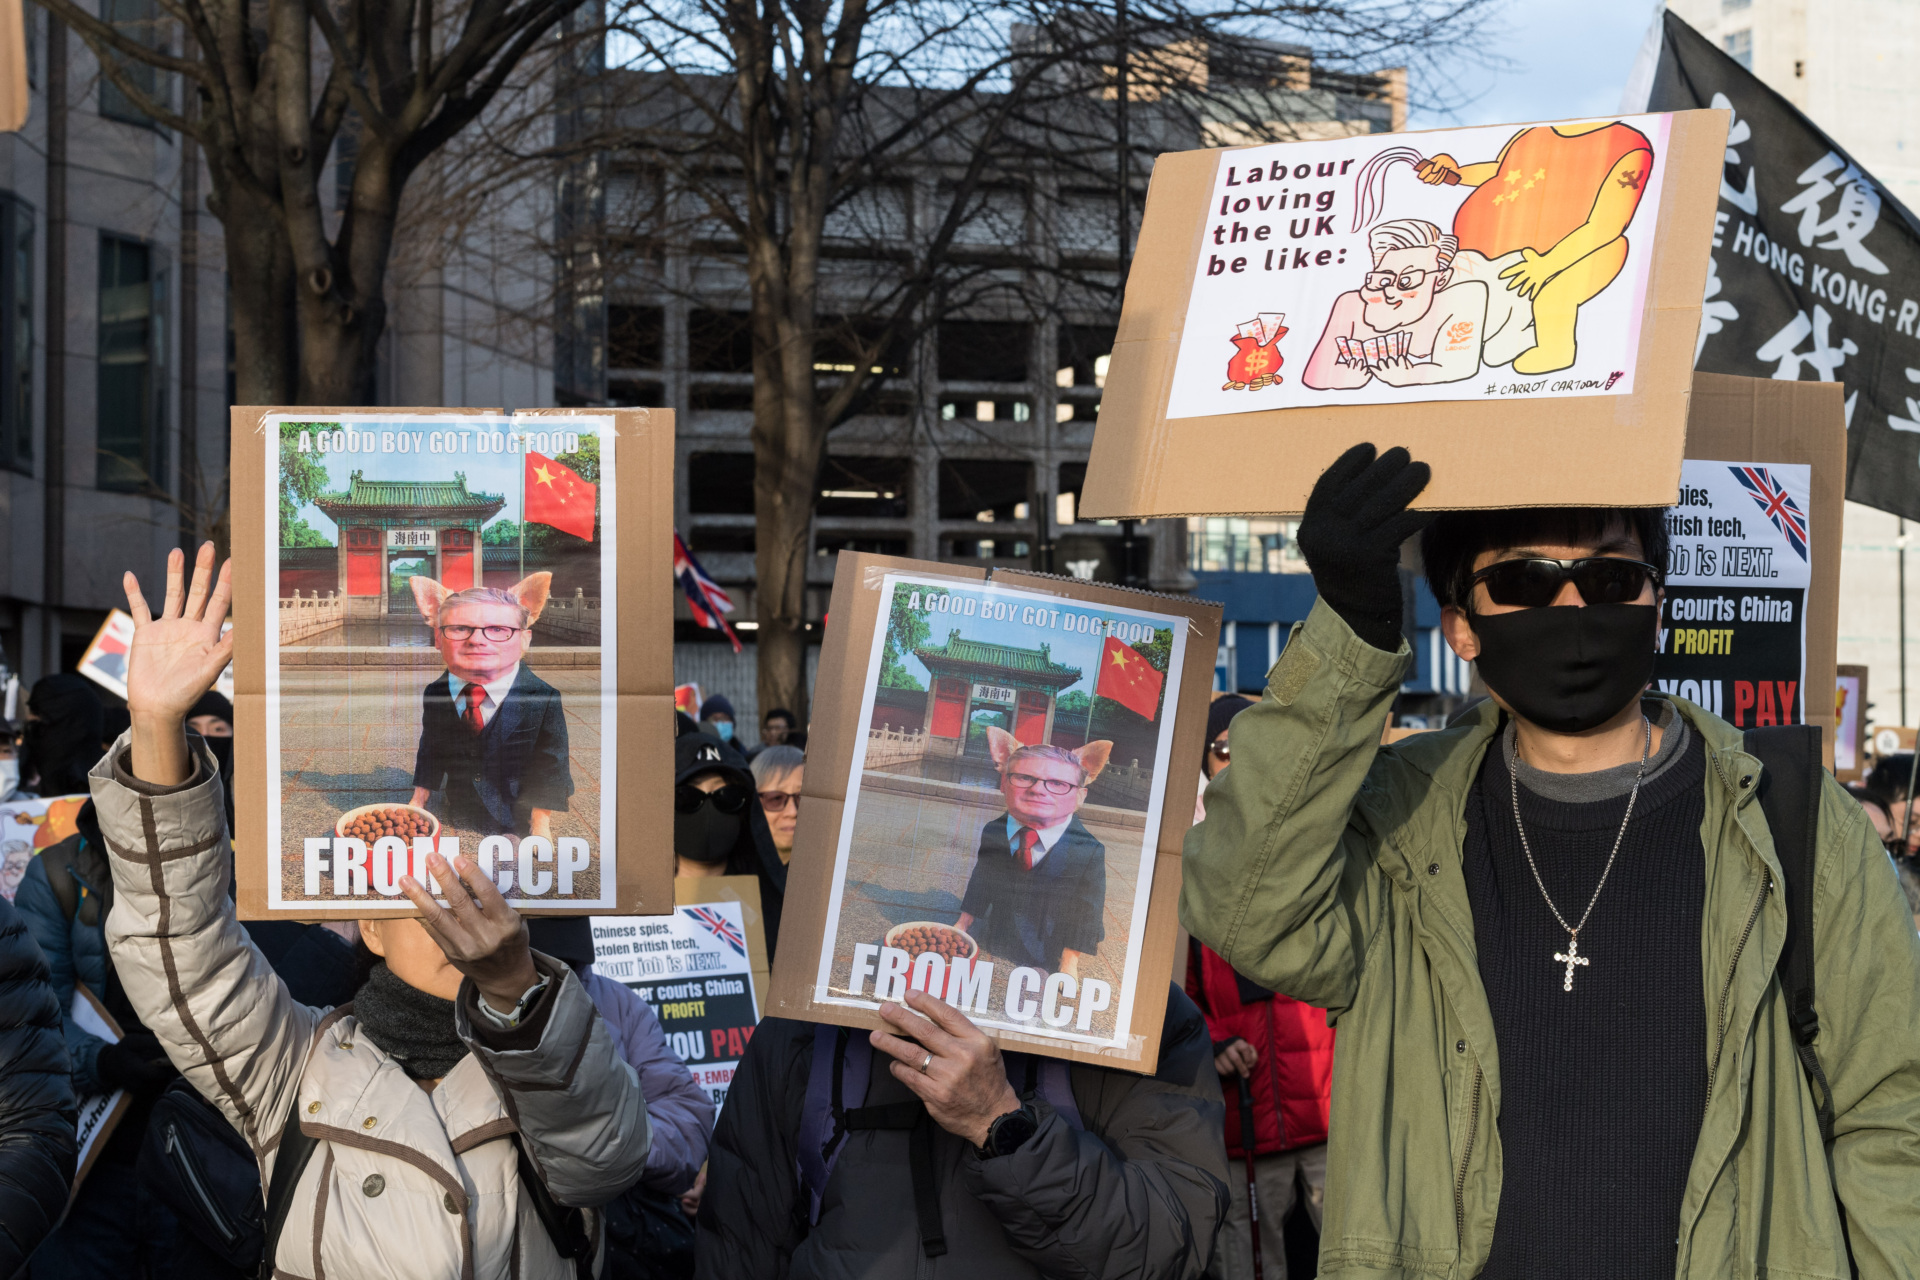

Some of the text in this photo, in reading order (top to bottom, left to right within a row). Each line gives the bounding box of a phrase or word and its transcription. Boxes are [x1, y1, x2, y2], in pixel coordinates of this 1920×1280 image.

[1226, 159, 1355, 186] Labour
[1220, 188, 1335, 216] loving
[1213, 215, 1336, 245] the UK
[1207, 248, 1347, 276] be like:
[1732, 221, 1805, 287] HONG
[298, 430, 579, 454] A GOOD BOY GOT DOG FOOD
[1675, 484, 1713, 509] pies,
[1668, 515, 1746, 540] itish tech,
[1667, 544, 1778, 578] ob is NEXT.
[907, 591, 1155, 644] A GOOD BOY GOT DOG FOOD
[1671, 596, 1735, 622] courts
[1740, 595, 1793, 623] China
[1673, 628, 1734, 655] PROFIT
[1734, 680, 1797, 727] PAY
[304, 835, 590, 896] FROM CCP
[593, 923, 673, 939] Chinese spies,
[596, 937, 700, 957] stolen British tech,
[597, 952, 727, 978] Your job is NEXT.
[657, 981, 702, 1001] courts
[705, 979, 744, 996] China
[849, 943, 1112, 1031] FROM CCP
[662, 1001, 705, 1019] PROFIT
